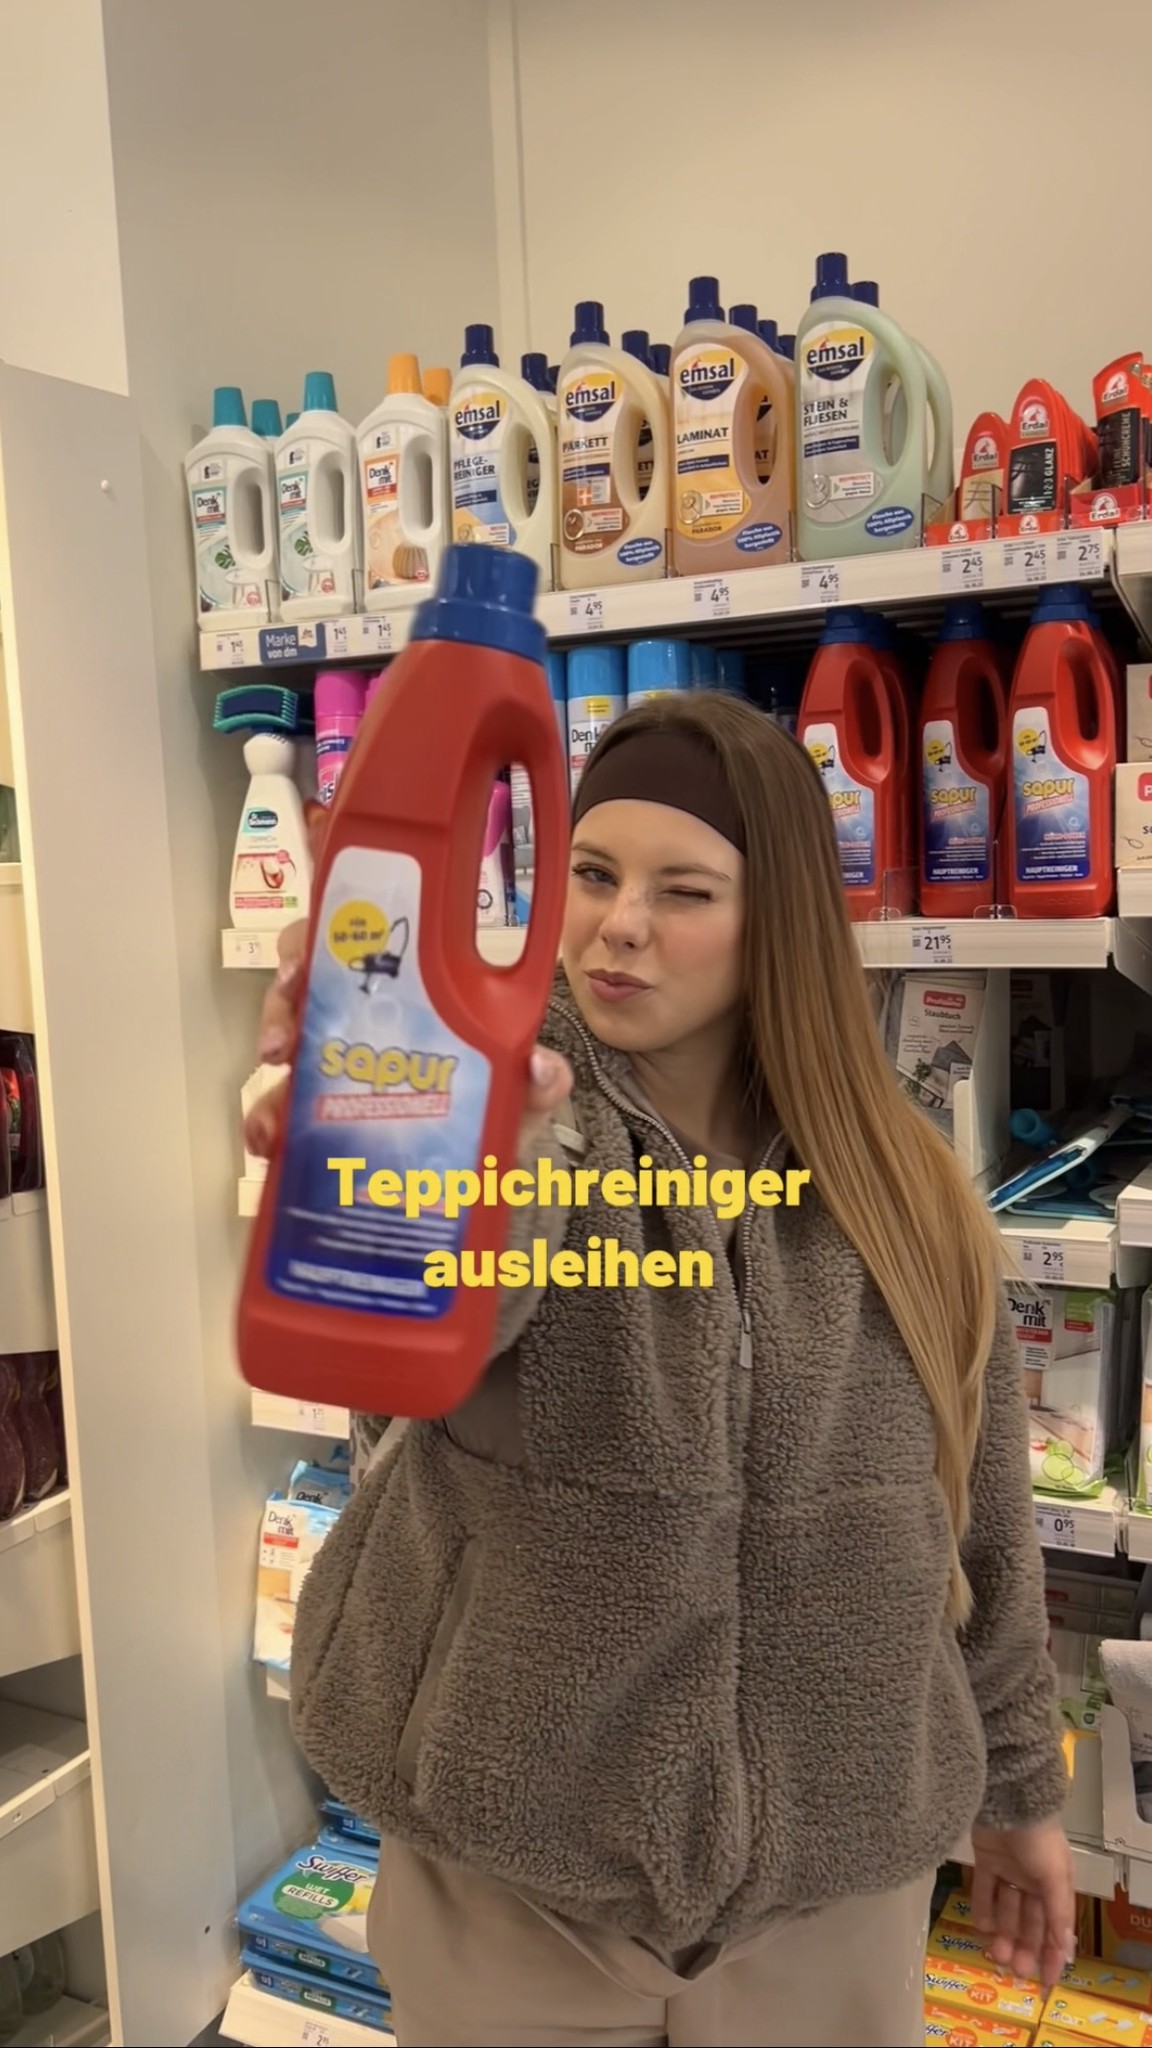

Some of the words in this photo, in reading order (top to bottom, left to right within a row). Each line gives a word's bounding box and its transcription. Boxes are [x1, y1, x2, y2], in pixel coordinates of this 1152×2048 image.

[807, 336, 865, 365] emsal
[680, 358, 735, 384] emsal
[565, 381, 616, 406] emsal
[1102, 385, 1128, 400] Erdal
[455, 400, 501, 426] emsal
[804, 399, 835, 416] STEIN
[839, 398, 849, 408] &
[803, 409, 848, 428] FLIESEN
[1021, 421, 1048, 430] Erdal
[677, 427, 729, 445] LAMINAT
[562, 437, 609, 453] PARKETT
[973, 452, 998, 462] Erdal
[369, 463, 391, 479] Denk
[453, 464, 496, 481] REINIGER
[282, 480, 301, 494] Denk
[196, 495, 218, 508] Denk
[1090, 510, 1120, 520] Erdal
[265, 633, 297, 648] Marke
[267, 648, 283, 659] von
[284, 646, 298, 657] dm
[930, 786, 977, 806] sapur
[1022, 777, 1075, 801] sapur
[830, 790, 861, 809] pur
[924, 1009, 961, 1020] Staubtuch
[319, 1038, 460, 1095] sapur
[1023, 1314, 1046, 1327] mit
[268, 1510, 293, 1527] Denk
[277, 1525, 294, 1536] mit
[298, 1855, 367, 1883] Swiffer
[305, 1882, 330, 1894] WET
[288, 1886, 334, 1907] REFILLS
[1130, 1914, 1152, 1929] DU
[936, 1934, 983, 1952] Swiffer
[925, 1973, 968, 1992] Swiffer
[970, 1990, 994, 2003] KIT
[926, 2024, 948, 2037] ffer
